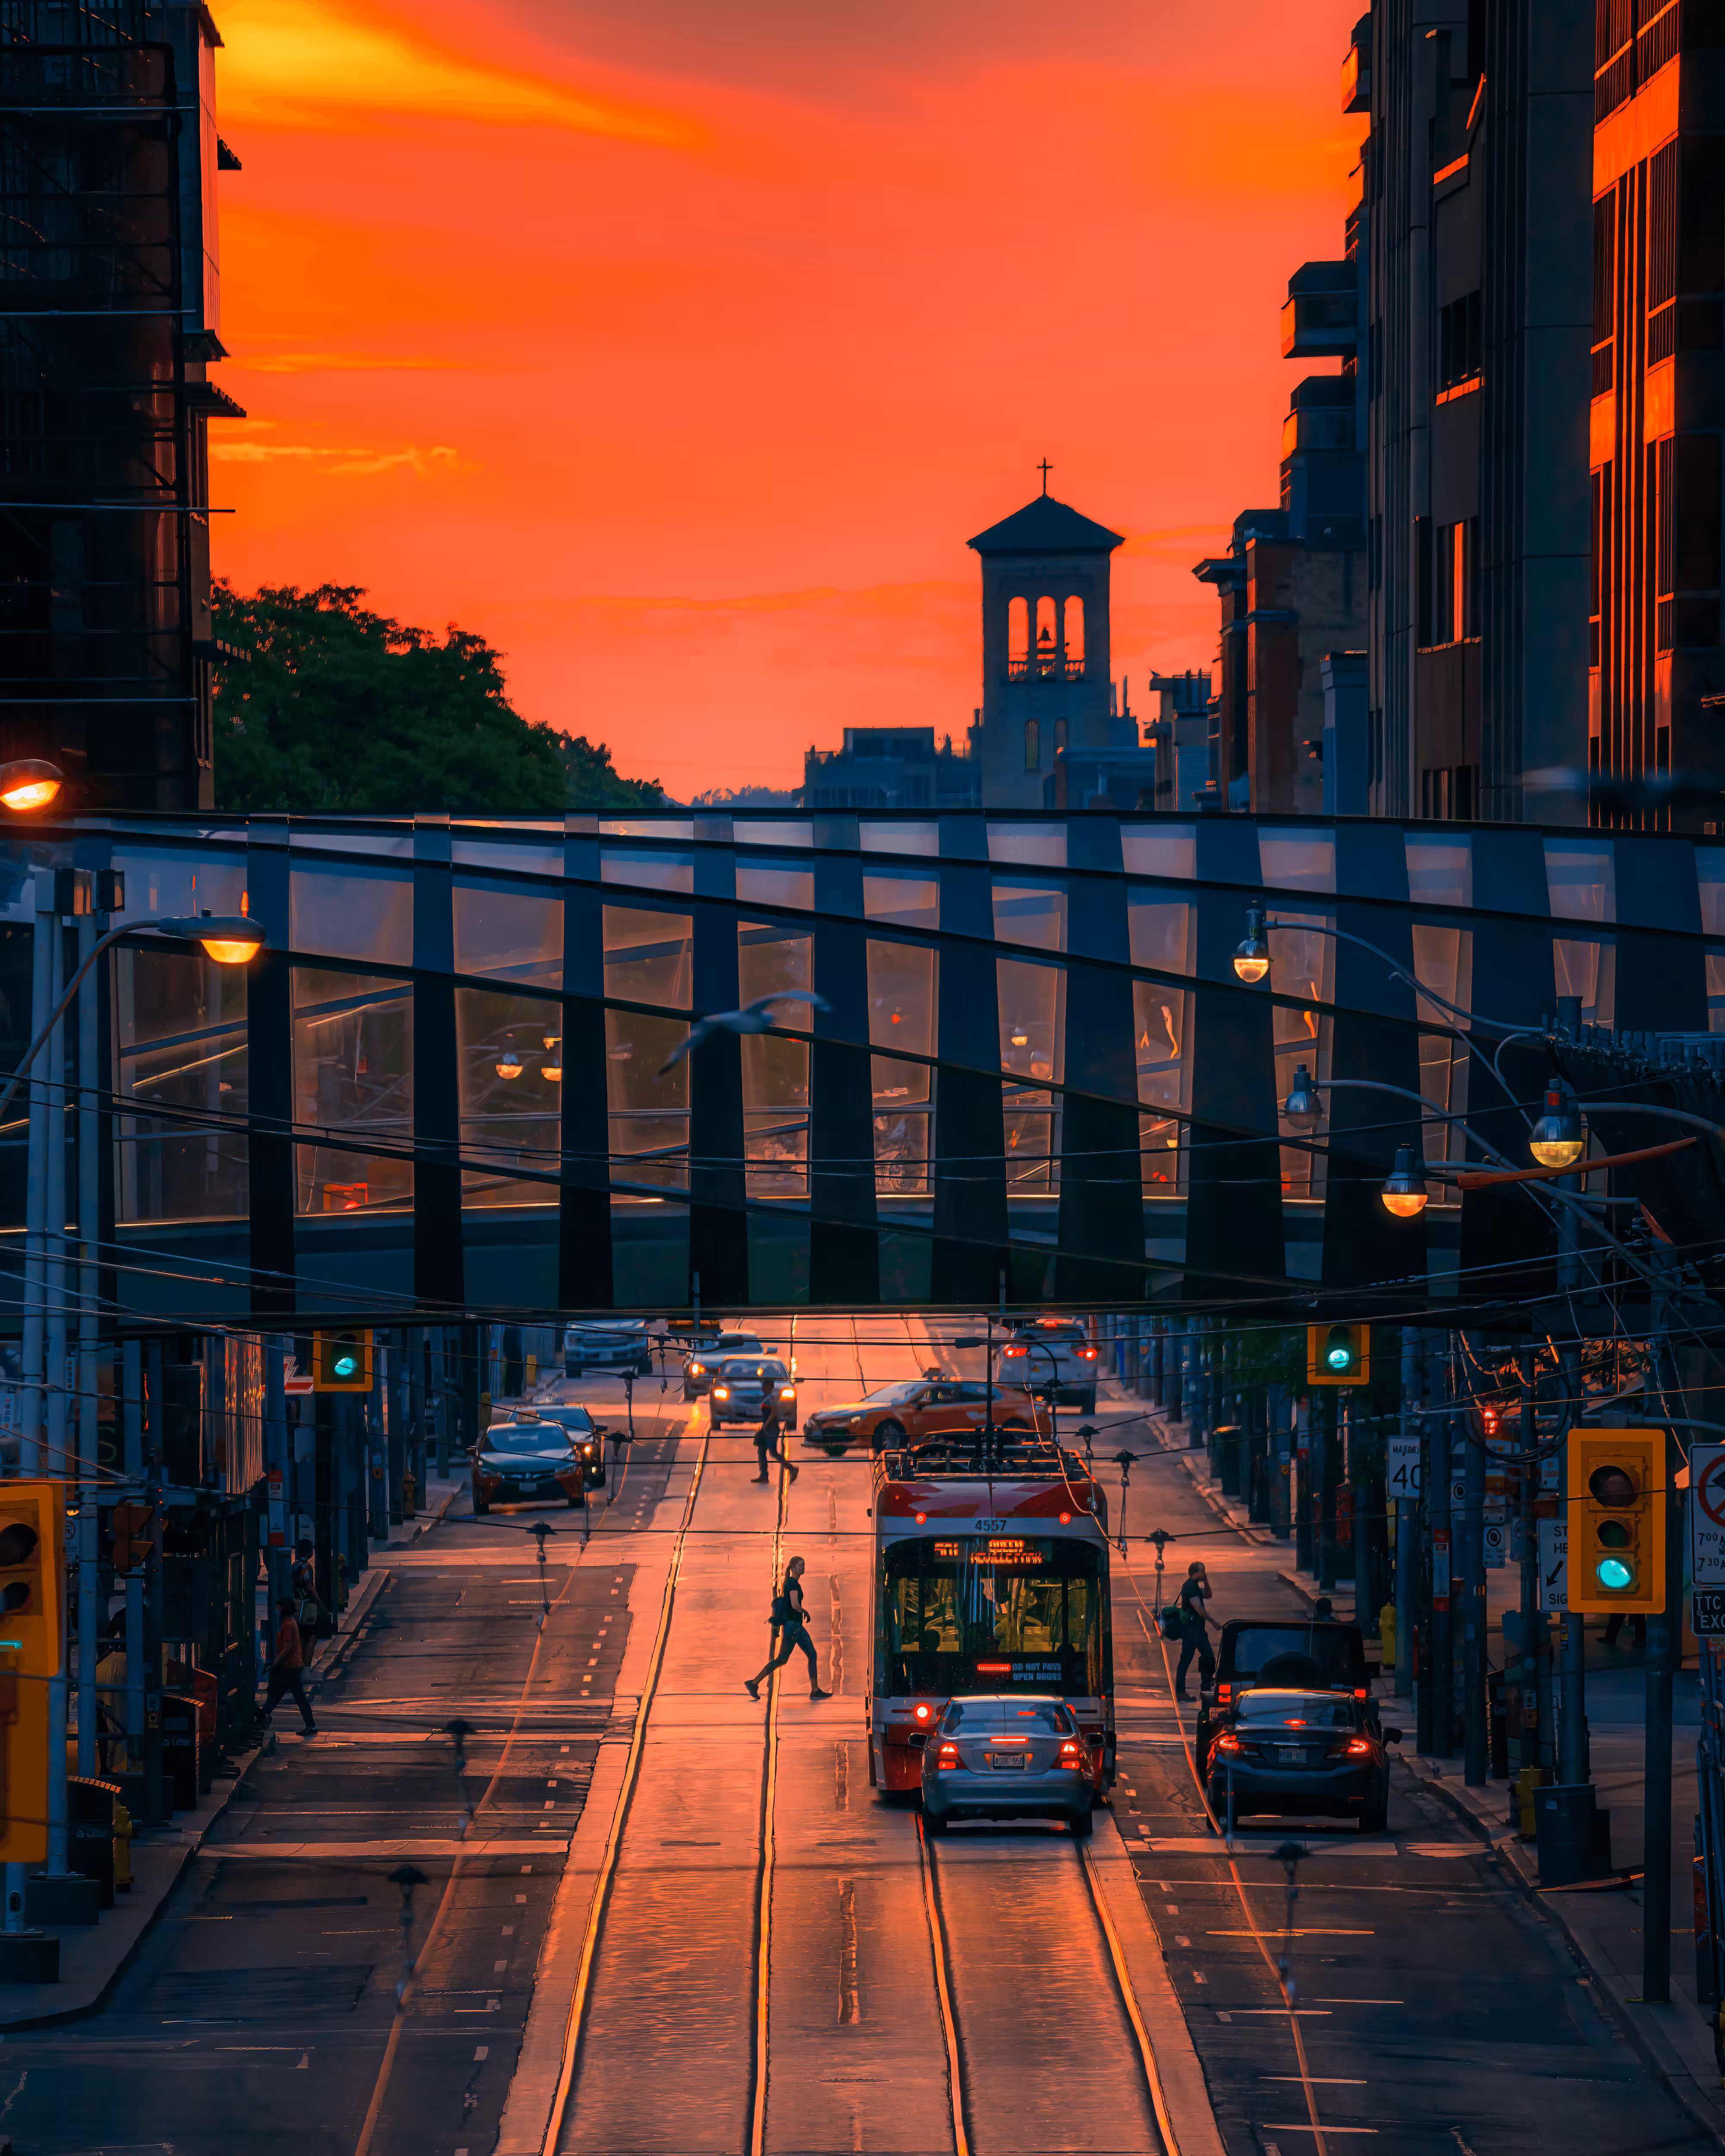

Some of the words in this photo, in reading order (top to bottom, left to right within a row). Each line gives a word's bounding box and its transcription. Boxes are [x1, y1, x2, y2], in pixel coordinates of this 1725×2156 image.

[1393, 1464, 1421, 1489] 40
[1554, 1526, 1567, 1537] ST
[1554, 1543, 1568, 1553] HE
[1549, 1593, 1567, 1604] SIG
[1696, 1596, 1722, 1611] TTC
